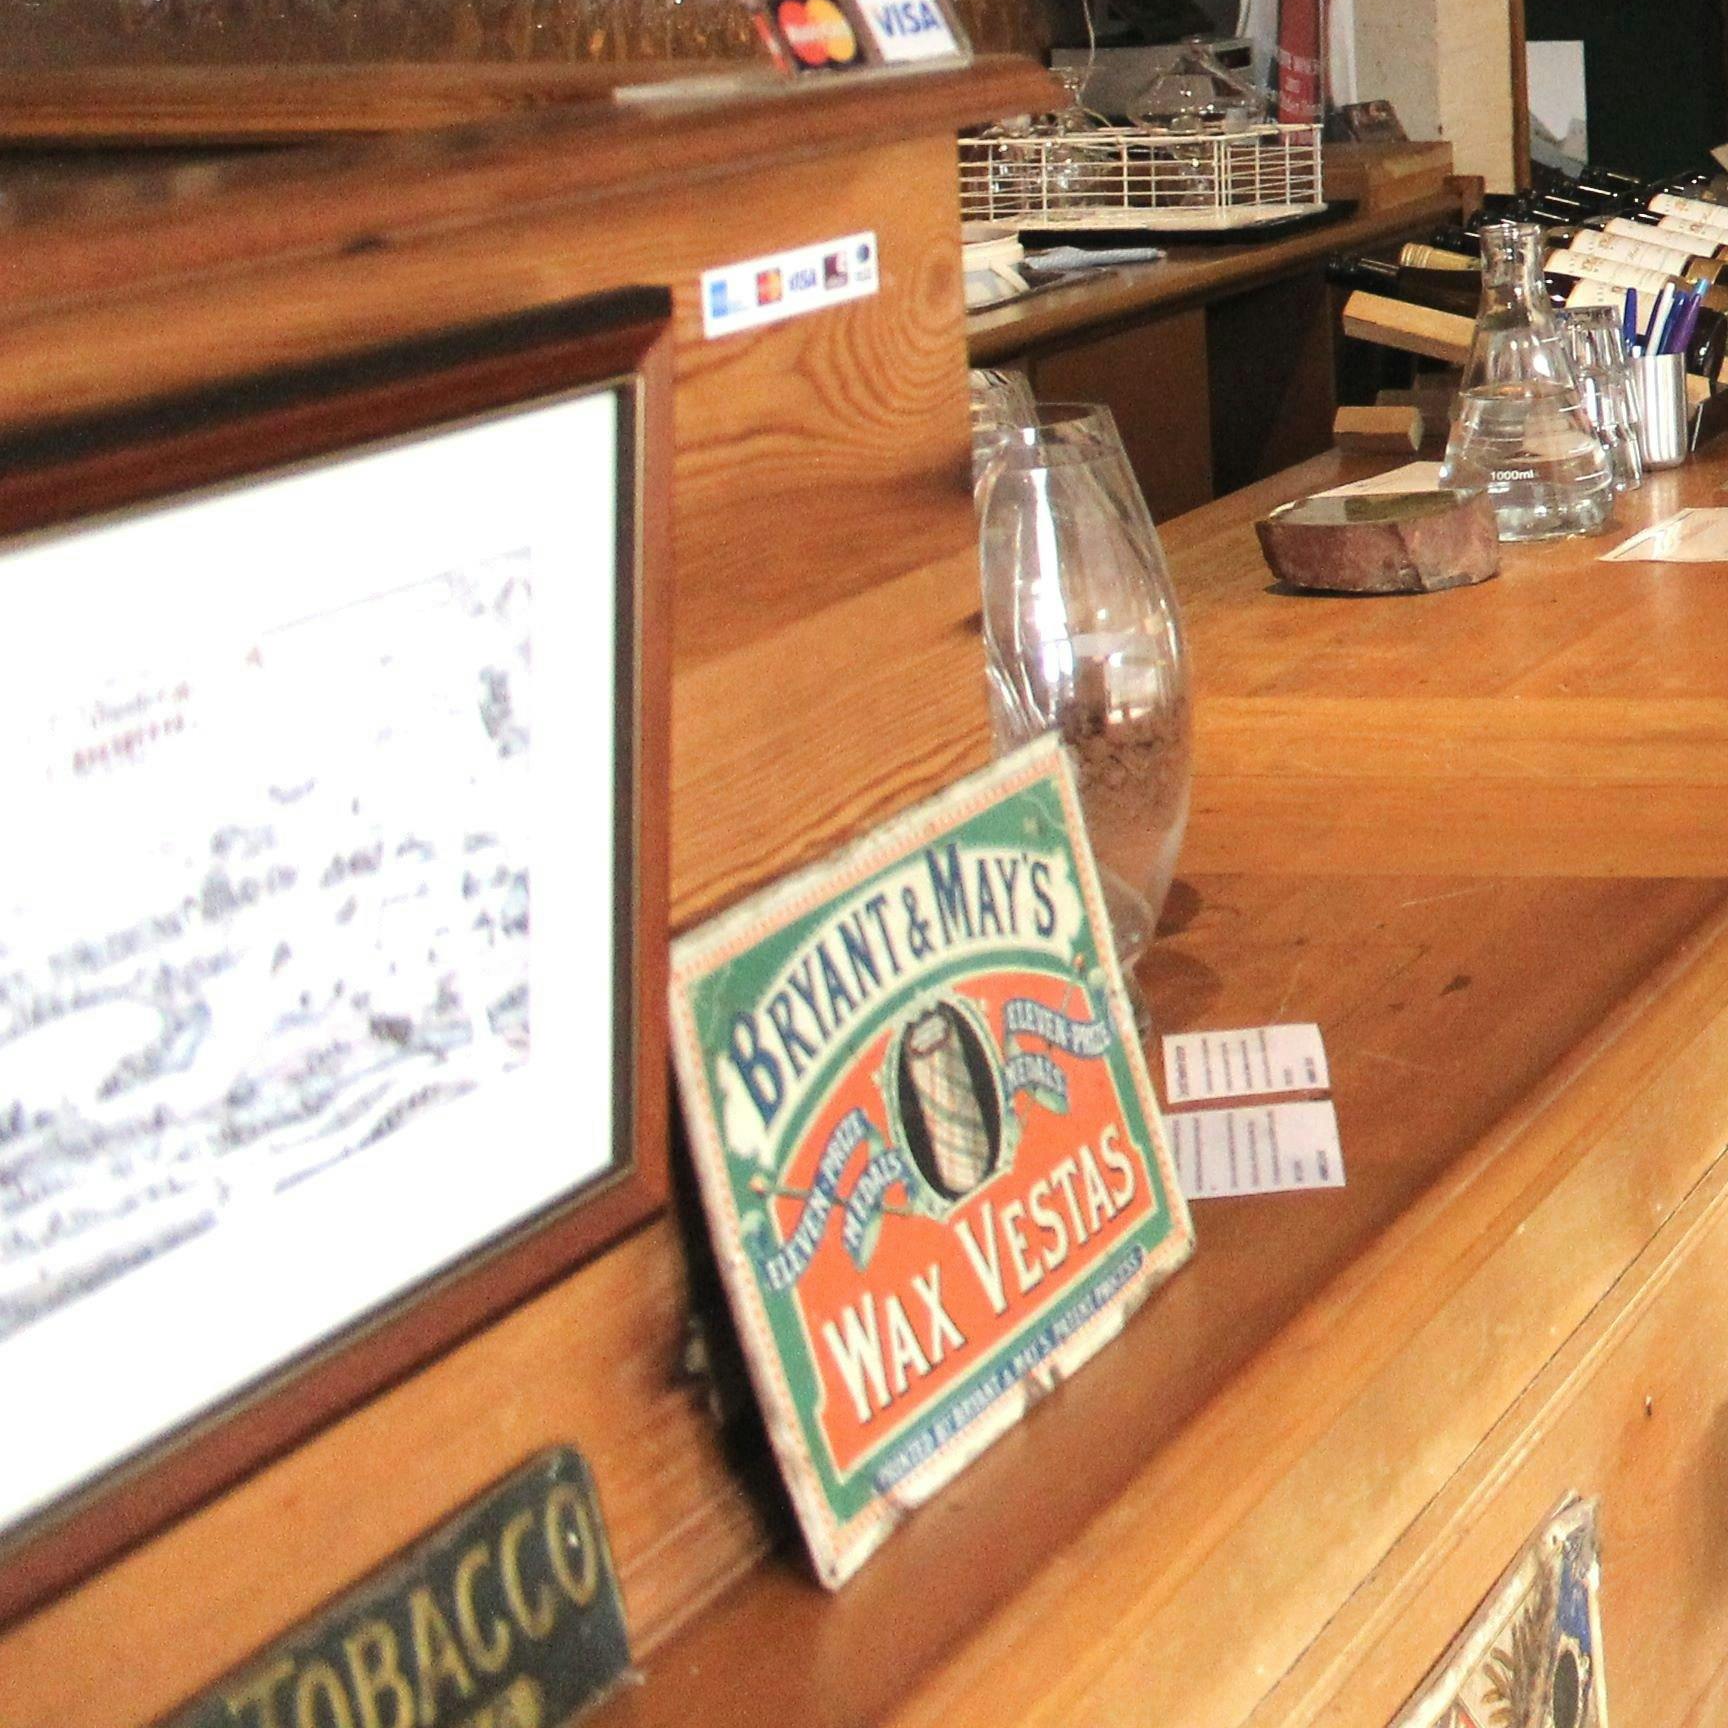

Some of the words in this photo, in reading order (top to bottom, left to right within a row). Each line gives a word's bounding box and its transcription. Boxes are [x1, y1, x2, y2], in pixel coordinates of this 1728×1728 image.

[874, 0, 939, 38] VISA
[1490, 469, 1535, 481] 1000ml
[729, 892, 903, 1127] BRYANT
[900, 885, 936, 960] &
[926, 843, 1057, 945] MAY'S
[821, 1262, 967, 1425] WAX
[954, 1122, 1138, 1317] VESTAS
[225, 1485, 599, 1728] TOBACCO
